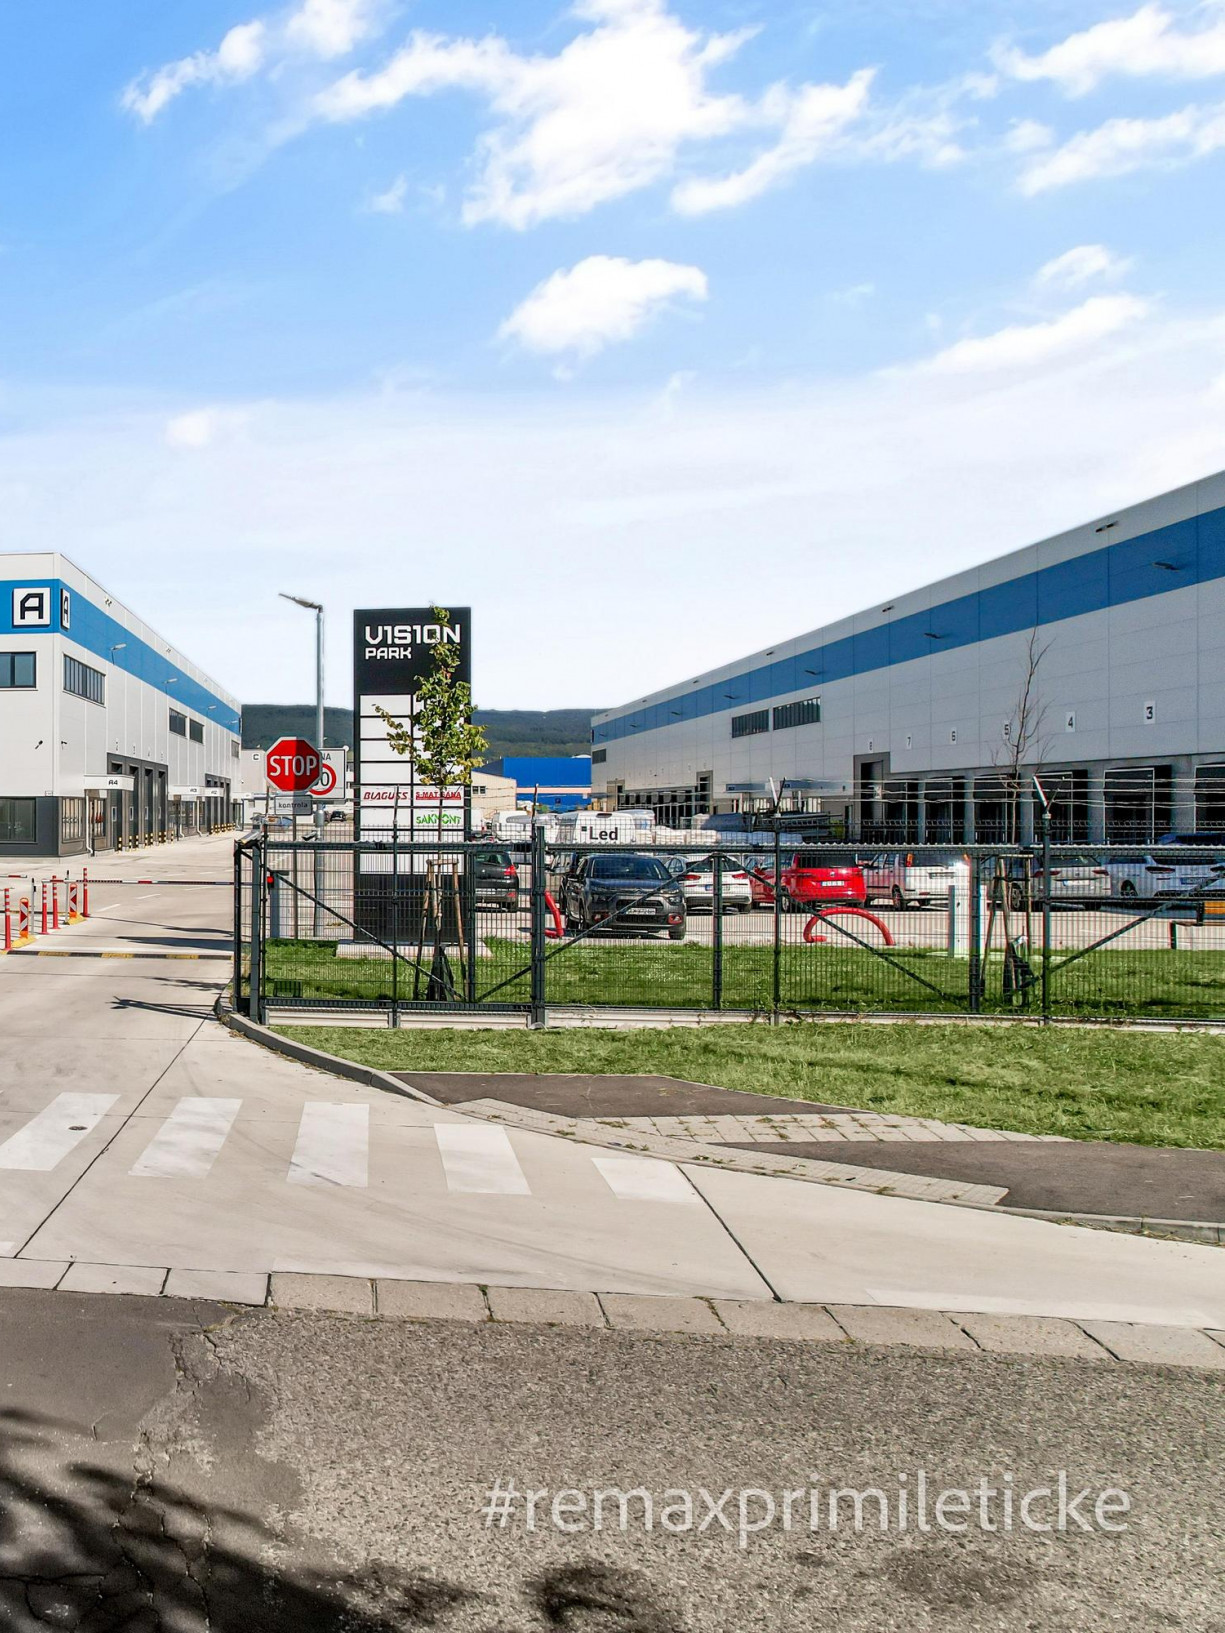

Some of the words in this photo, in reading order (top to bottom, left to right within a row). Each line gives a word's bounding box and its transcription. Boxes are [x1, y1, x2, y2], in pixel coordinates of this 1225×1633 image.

[20, 593, 44, 620] A
[365, 647, 412, 660] PARK
[1146, 706, 1154, 720] 3
[1068, 716, 1074, 728] 4
[269, 755, 318, 777] STOP
[589, 826, 619, 841] Led
